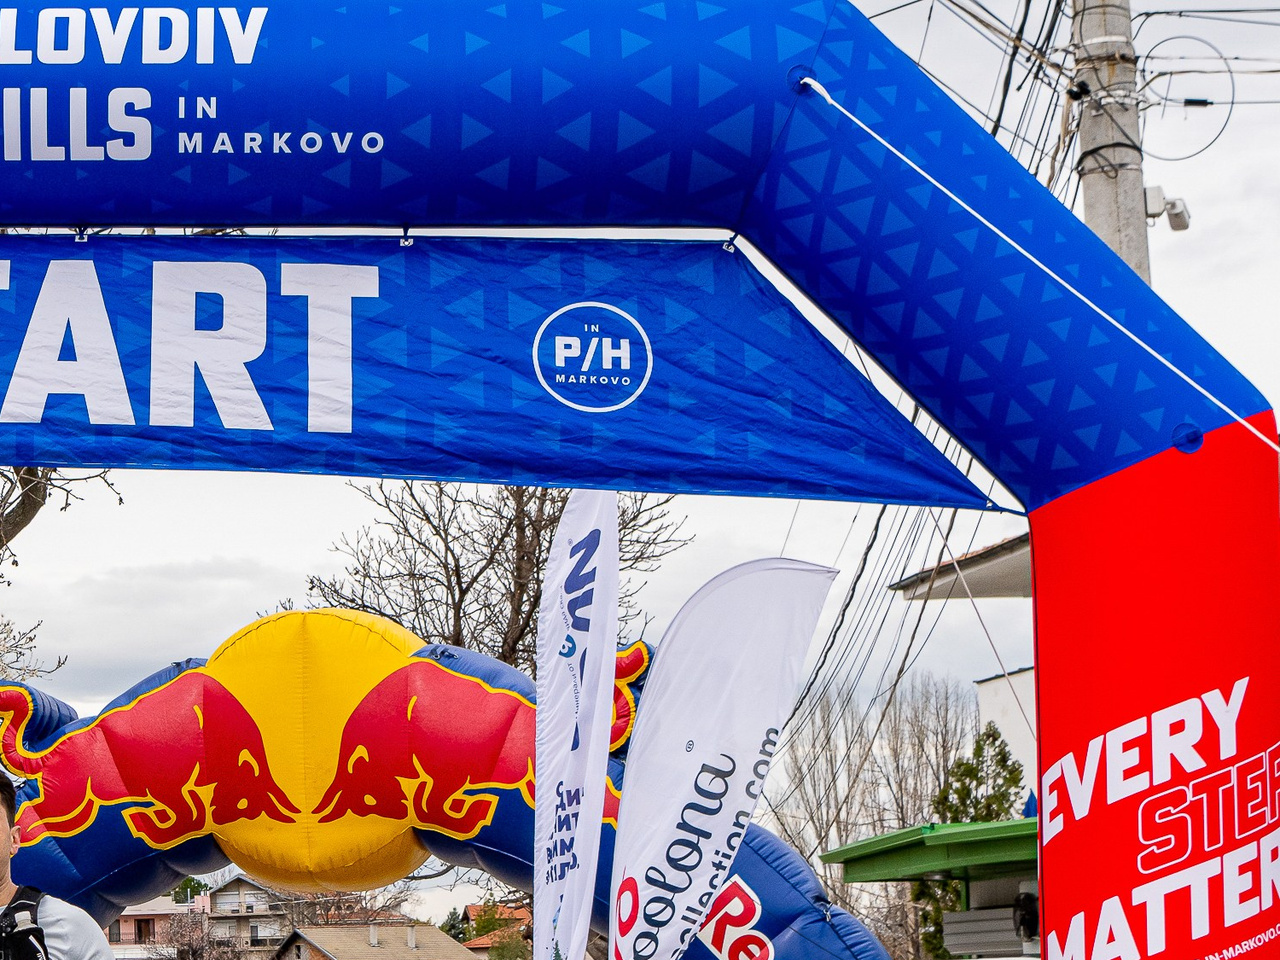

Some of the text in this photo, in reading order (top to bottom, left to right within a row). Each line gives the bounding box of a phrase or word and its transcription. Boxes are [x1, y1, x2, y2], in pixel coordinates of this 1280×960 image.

[178, 96, 218, 119] IN
[178, 131, 386, 155] MARKOVO
[584, 323, 599, 333] IN
[555, 336, 630, 371] P/H
[555, 374, 631, 386] MARKOVO
[1042, 677, 1249, 846] EVERY
